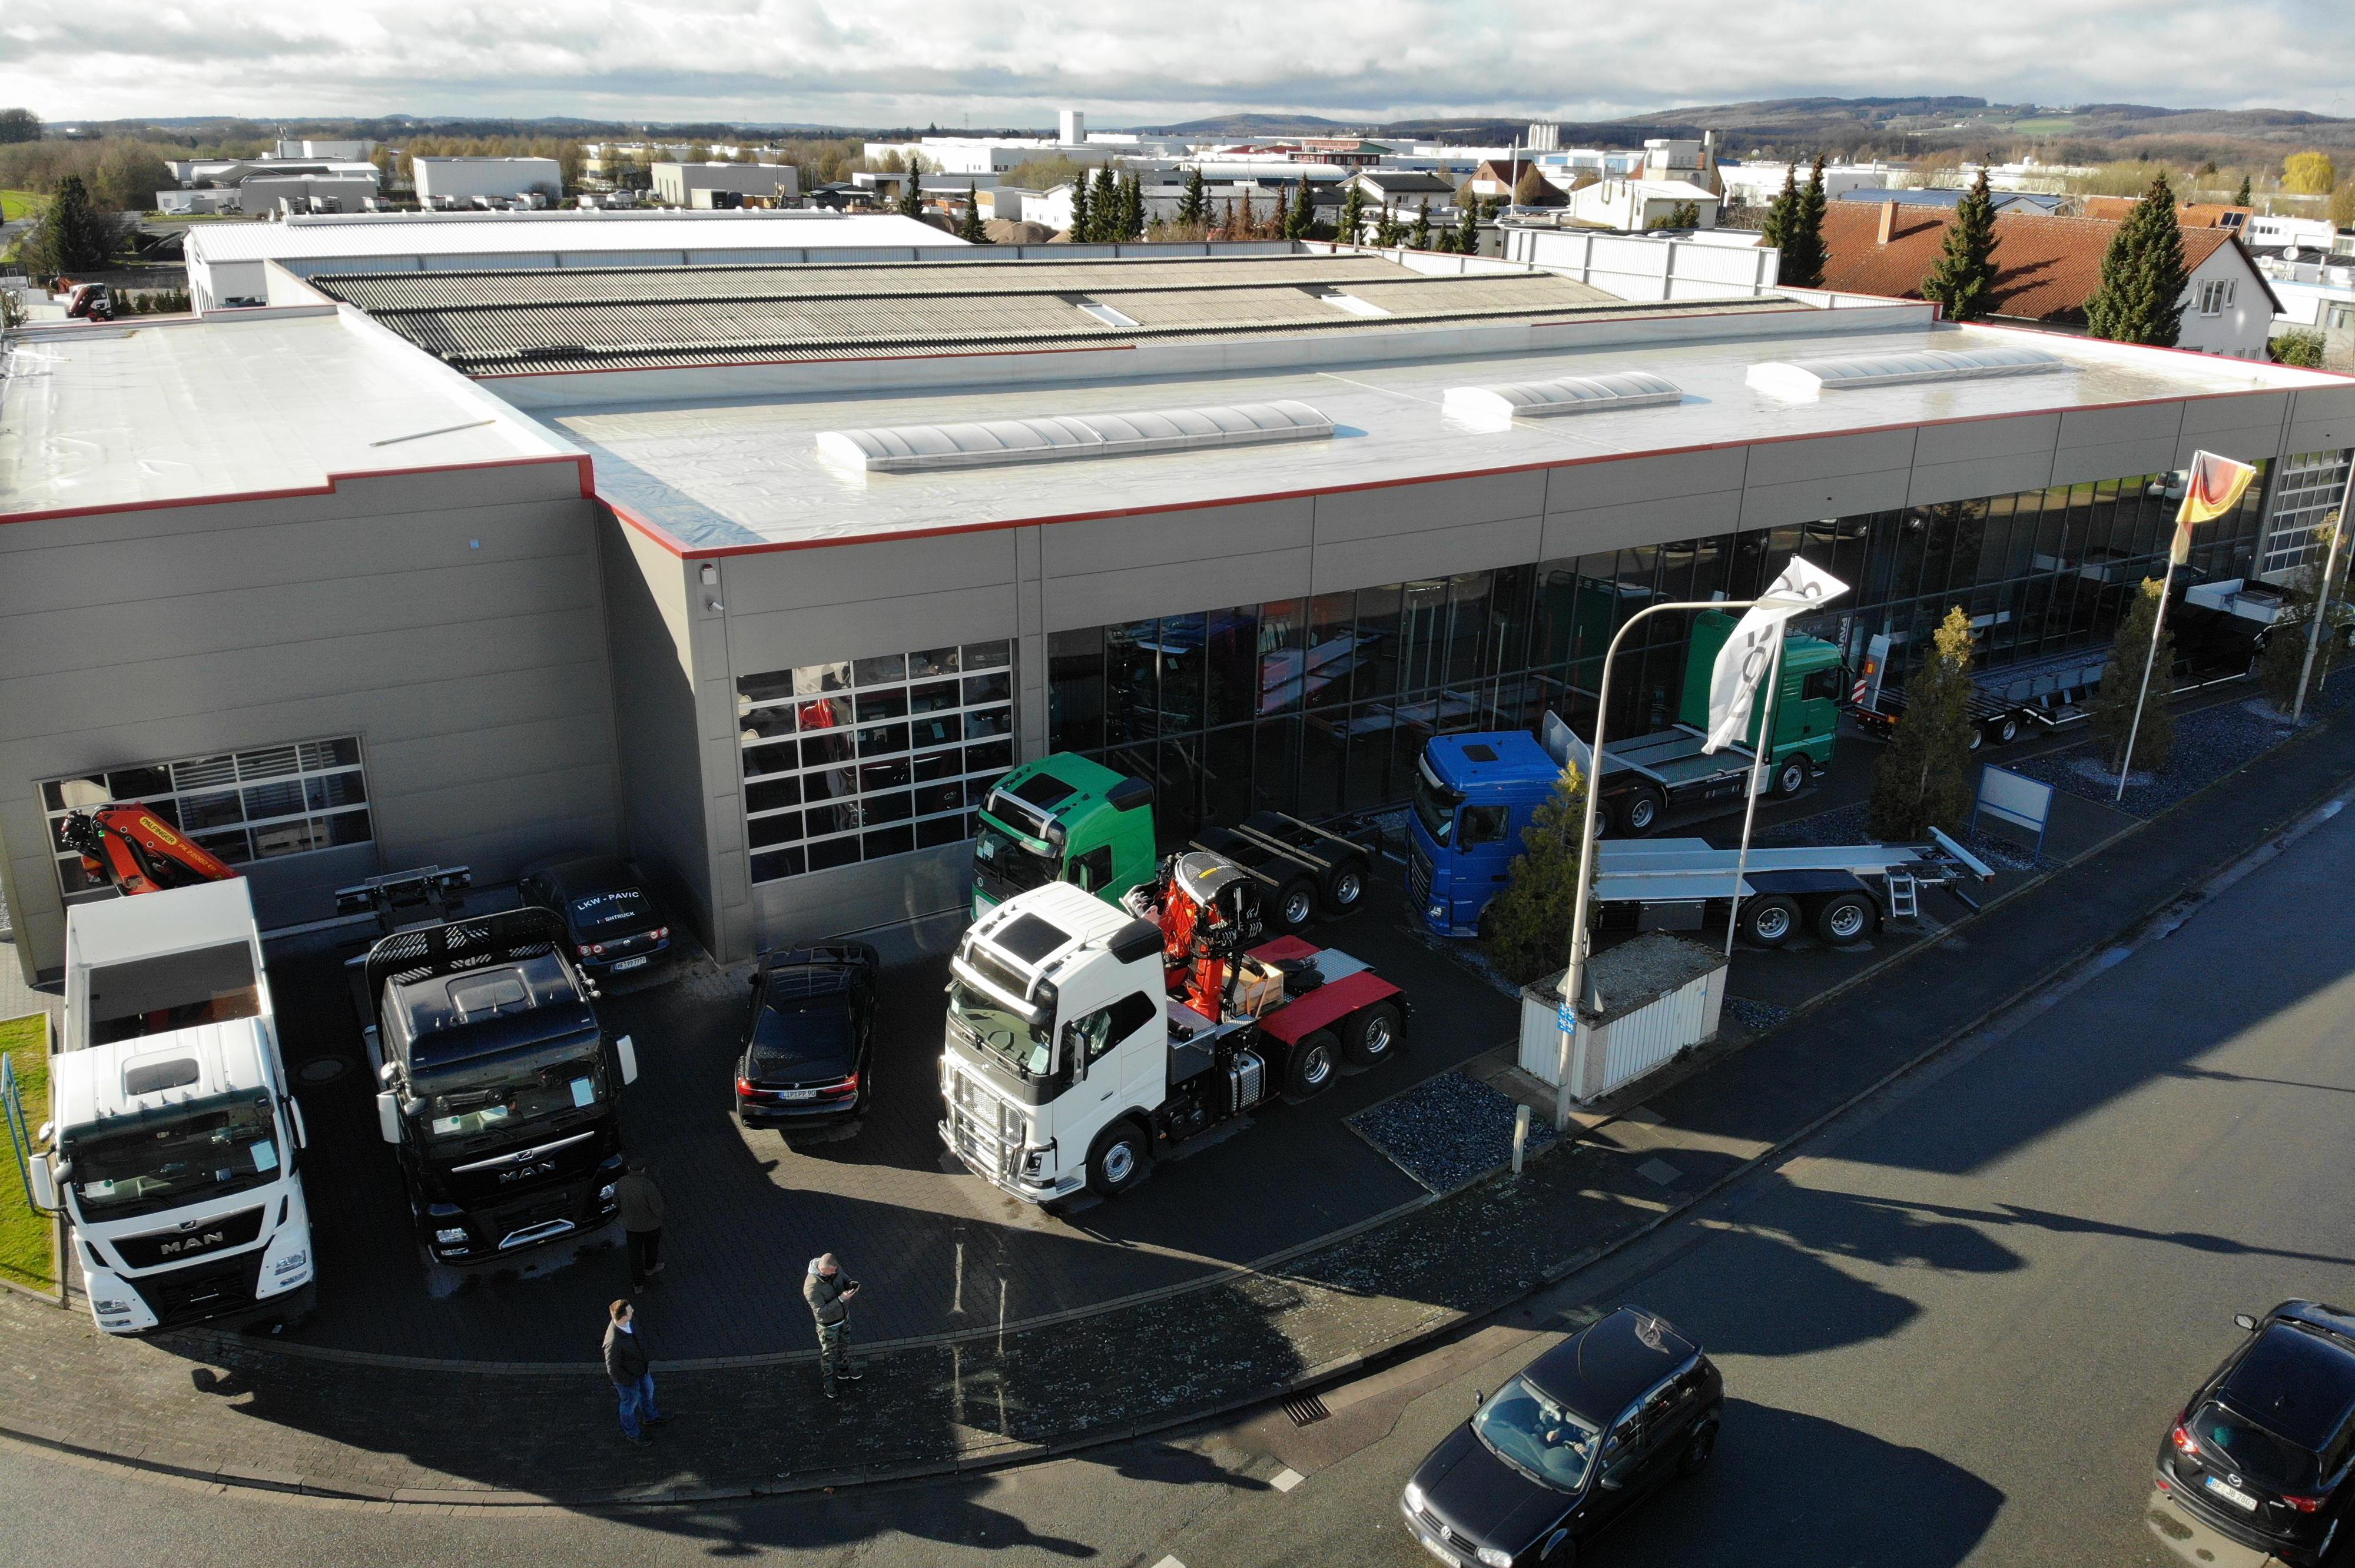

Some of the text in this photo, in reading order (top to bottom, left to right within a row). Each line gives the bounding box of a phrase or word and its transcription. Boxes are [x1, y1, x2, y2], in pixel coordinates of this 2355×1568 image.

[141, 818, 175, 843] PALFINGER
[577, 898, 601, 911] LKW
[608, 892, 639, 901] PAVIC
[499, 1161, 556, 1184] MAN
[161, 1231, 224, 1255] MAN
[2211, 1480, 2222, 1490] BF
[2226, 1488, 2236, 1498] JB
